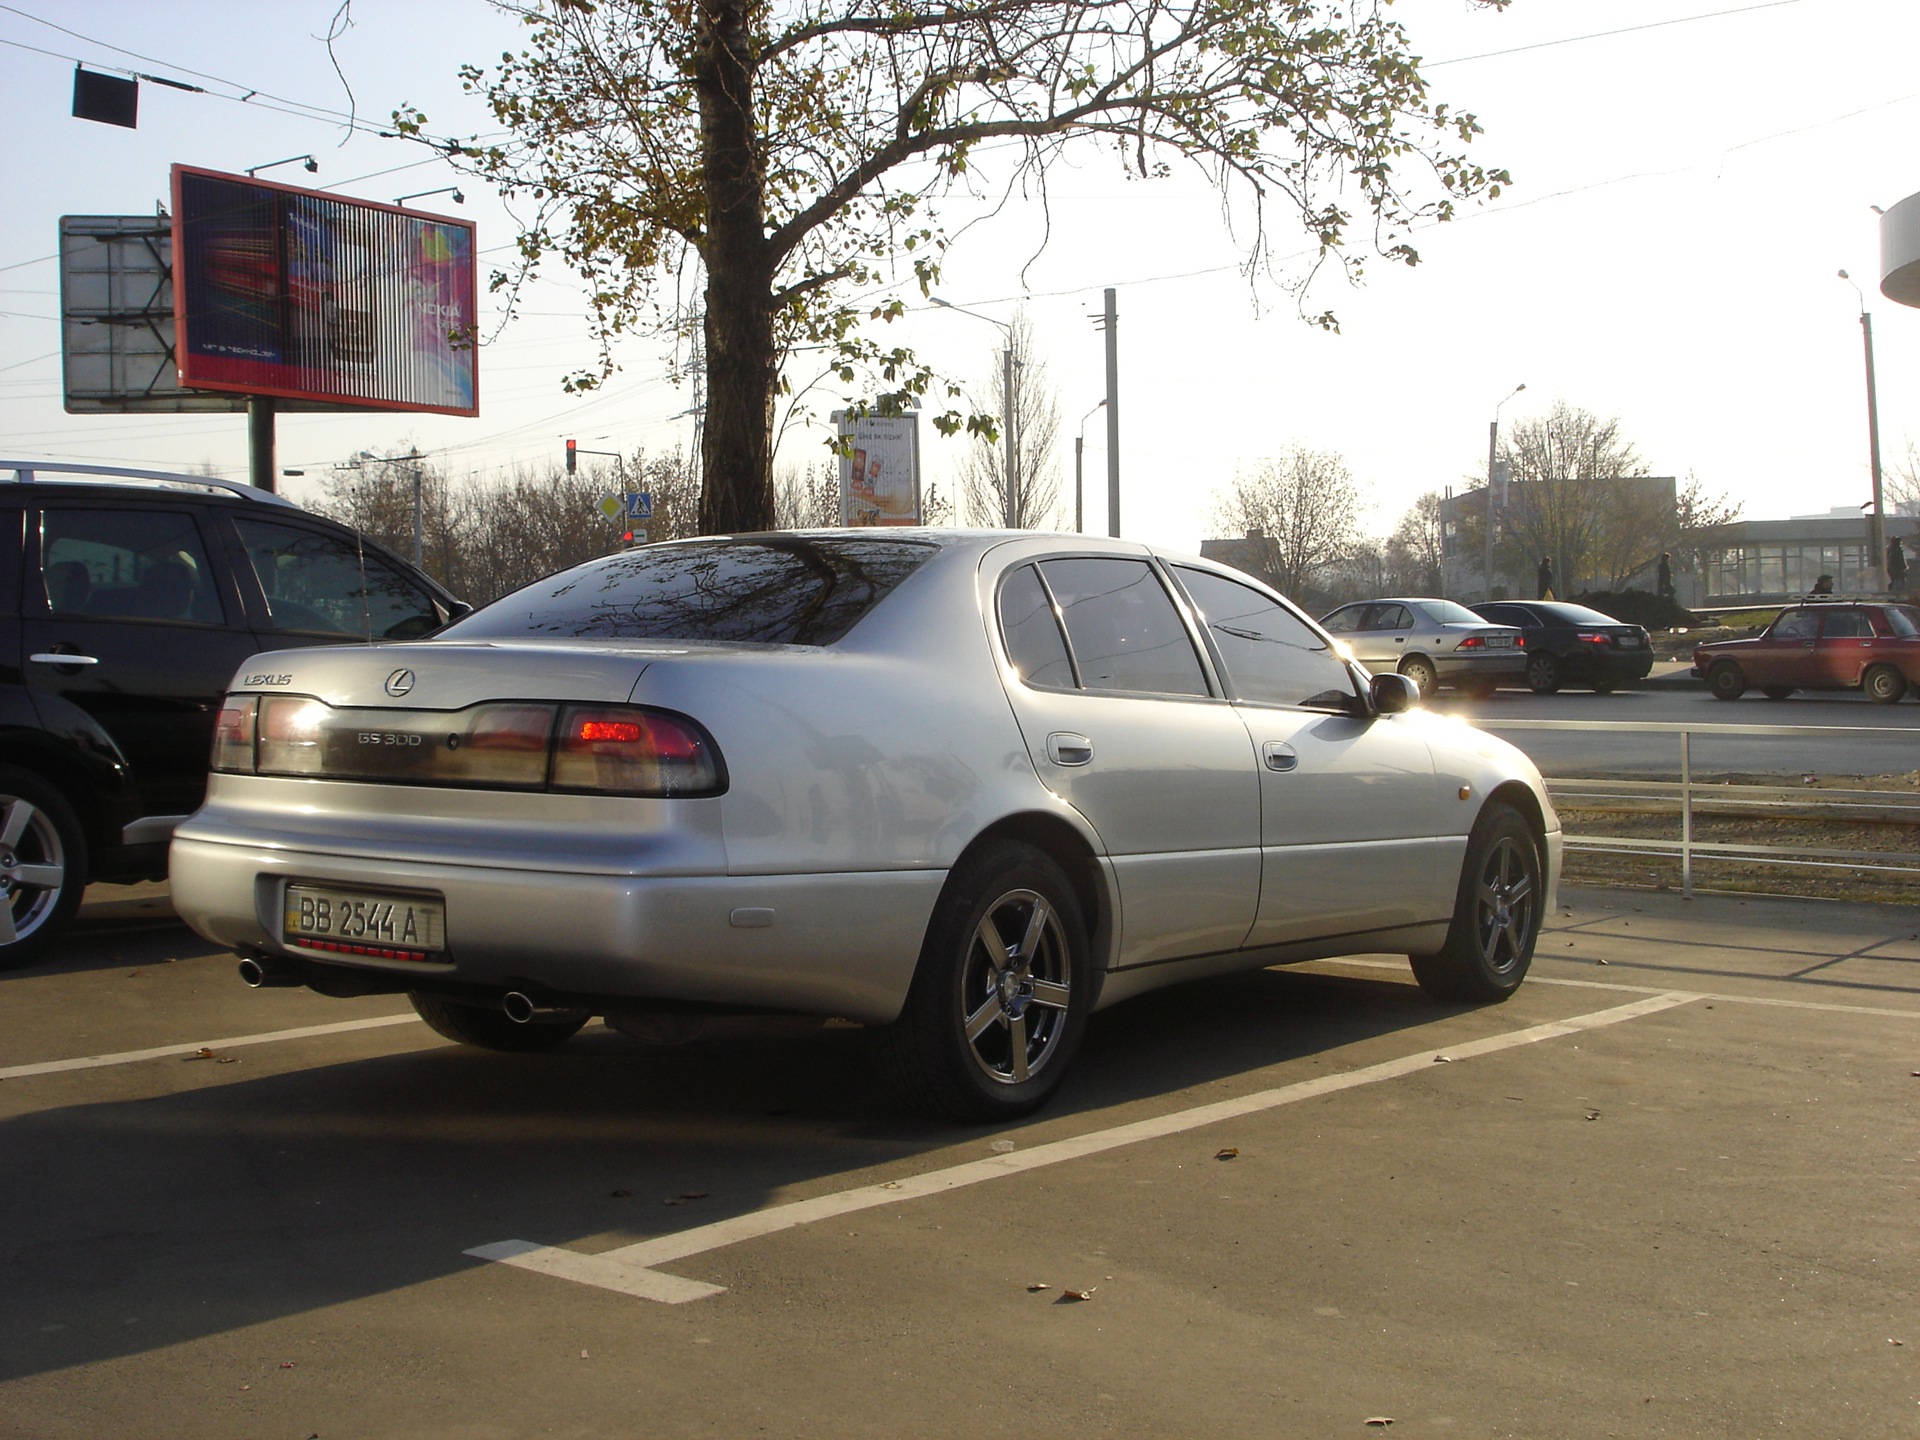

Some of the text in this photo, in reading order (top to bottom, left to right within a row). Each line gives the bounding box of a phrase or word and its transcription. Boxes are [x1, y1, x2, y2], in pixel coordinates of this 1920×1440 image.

[415, 302, 462, 317] NOKIA
[243, 674, 293, 686] LEXUS
[358, 732, 422, 746] GS 300
[301, 896, 333, 933] BB
[339, 901, 396, 942] 2544
